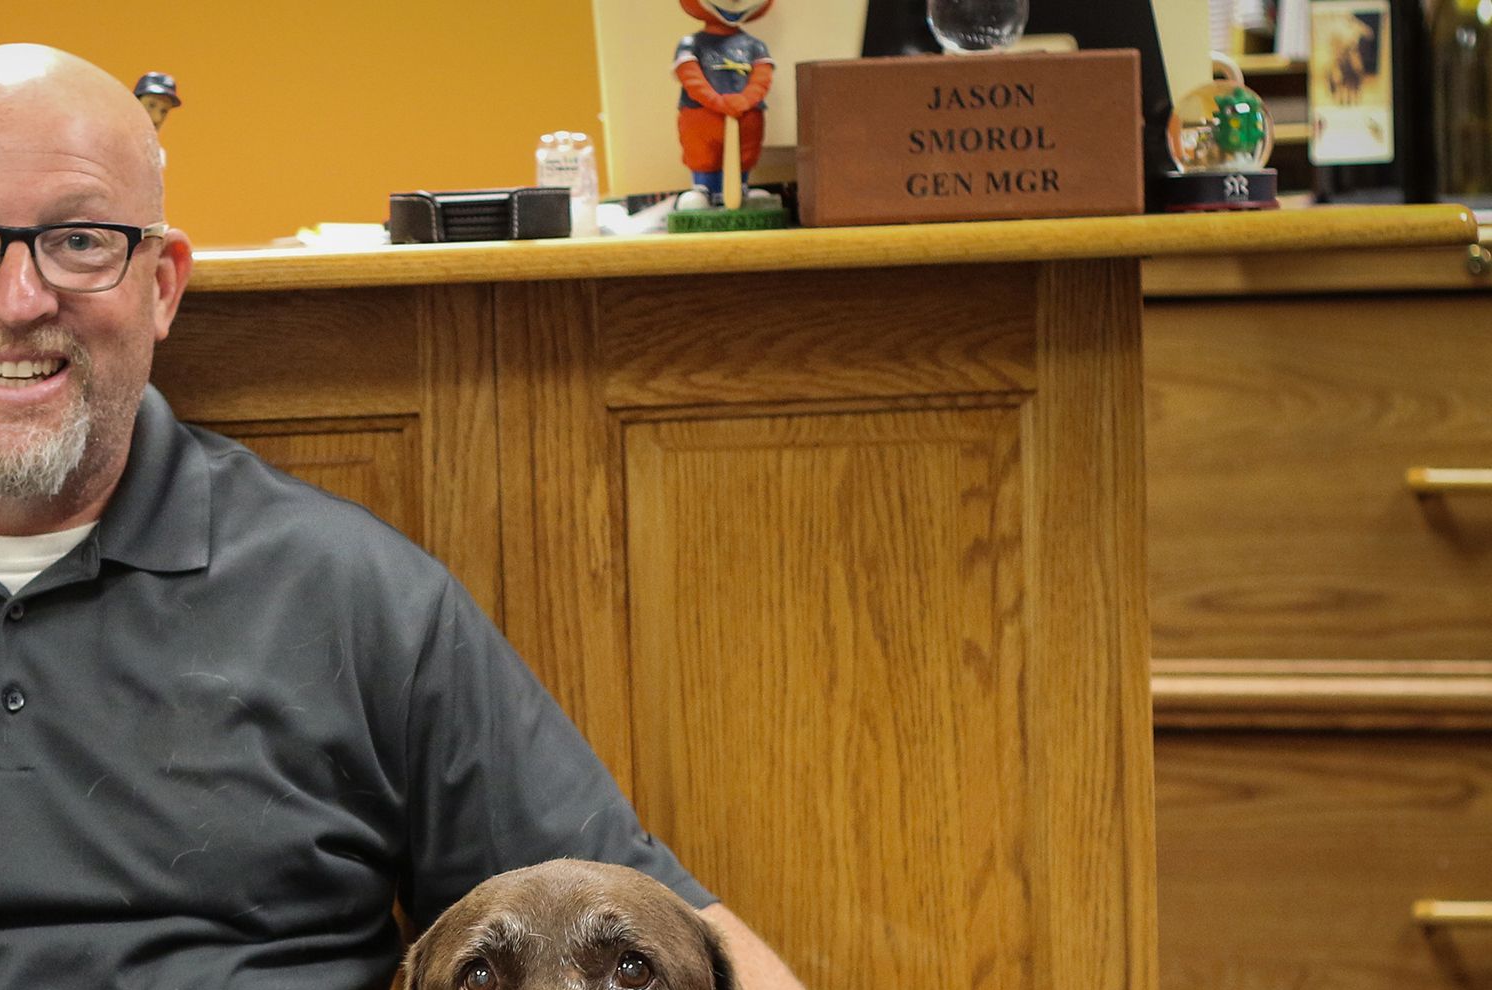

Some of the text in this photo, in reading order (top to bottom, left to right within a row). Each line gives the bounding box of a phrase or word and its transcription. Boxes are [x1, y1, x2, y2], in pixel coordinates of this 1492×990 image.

[927, 83, 1035, 111] JASON
[908, 125, 1056, 154] SMOROL
[906, 168, 1060, 197] GEN MGR
